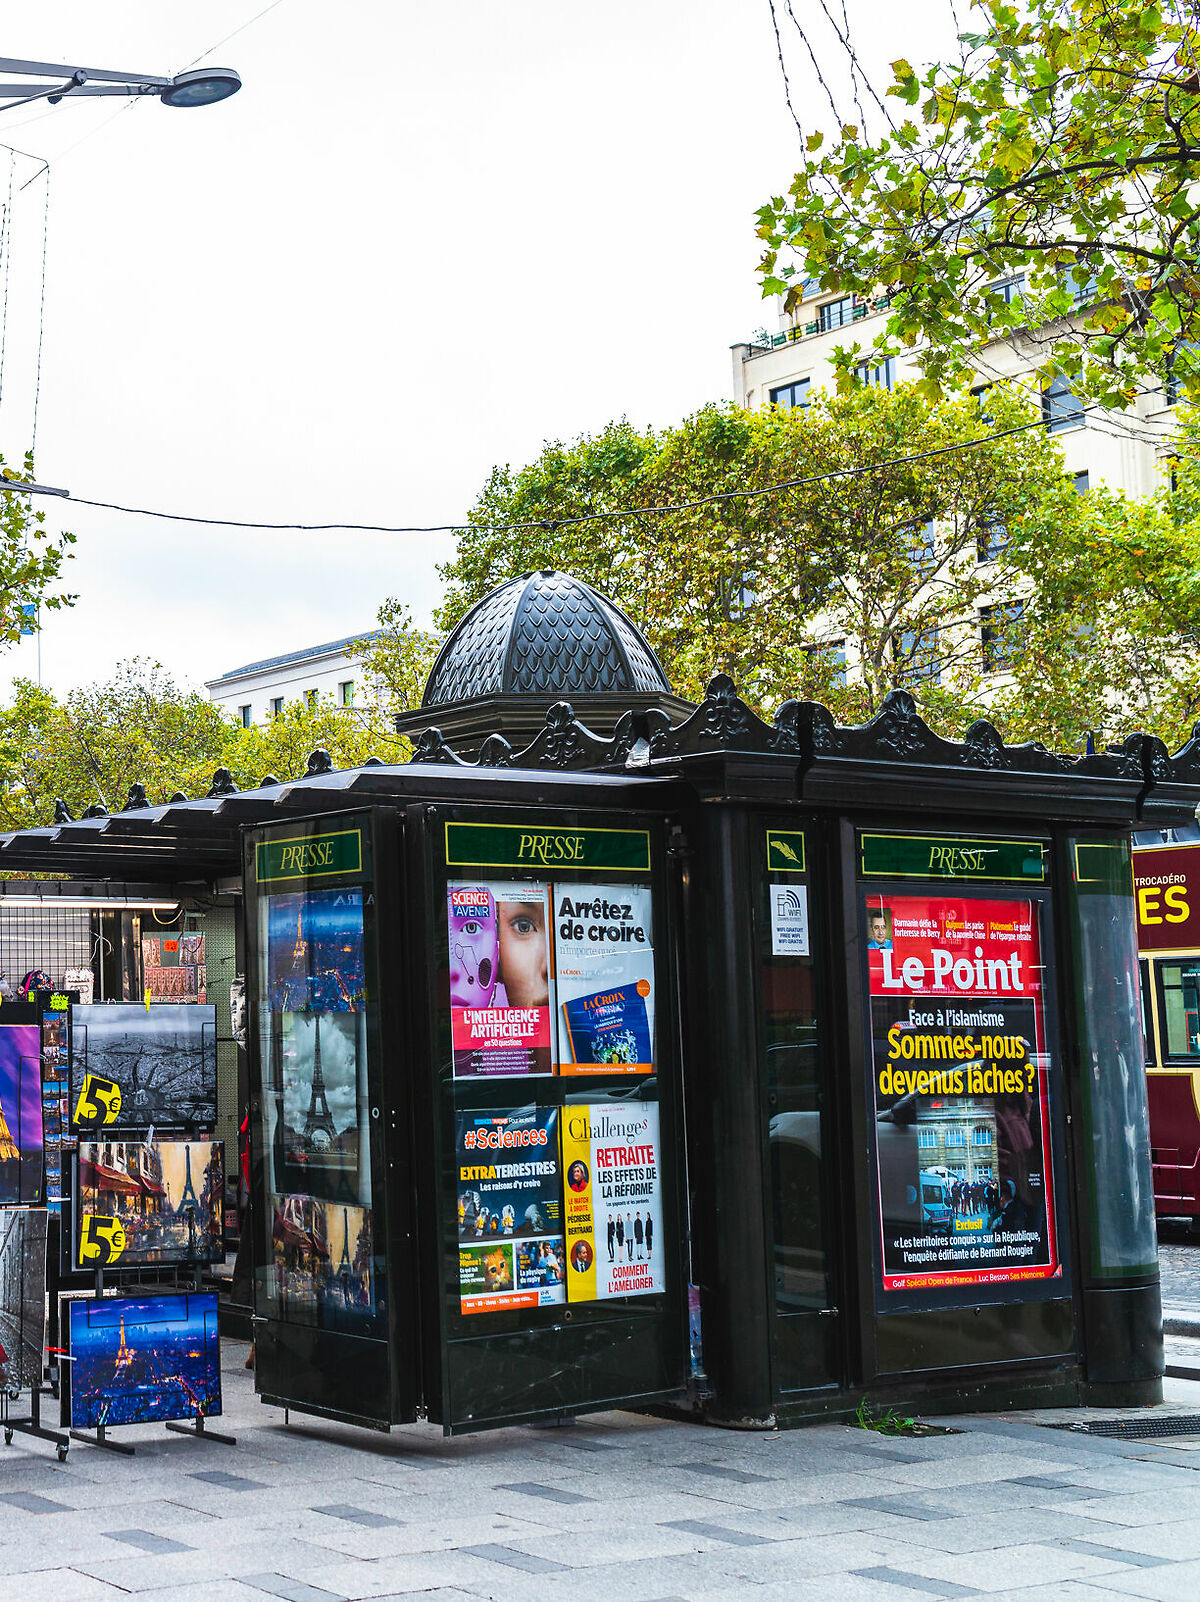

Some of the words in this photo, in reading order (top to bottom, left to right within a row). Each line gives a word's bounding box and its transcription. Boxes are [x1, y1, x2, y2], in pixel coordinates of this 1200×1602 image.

[280, 841, 335, 873] PRESSE
[517, 835, 585, 865] PRESSE
[928, 846, 986, 878] PRESSE
[1135, 873, 1187, 886] TROCADÉRO
[452, 892, 489, 906] SCIENCES
[456, 906, 489, 917] AVENIR
[559, 897, 634, 921] Arrêtez
[560, 919, 584, 941] de
[588, 922, 646, 943] croire
[894, 918, 919, 928] Darmanin
[932, 919, 938, 928] la
[920, 928, 927, 938] de
[945, 929, 952, 939] de
[990, 931, 996, 940] de
[880, 948, 925, 988] Le
[930, 946, 1024, 991] Point
[463, 1009, 540, 1024] L'INTELLIGENCE
[908, 1009, 935, 1026] Face
[936, 1009, 944, 1026] à
[946, 1009, 1005, 1027] l'islamisme
[470, 1023, 535, 1038] ARTIFICIELLE
[498, 1039, 523, 1048] questions
[887, 1028, 1025, 1060] Sommes-nous
[879, 1063, 964, 1095] devenus
[464, 1126, 548, 1149] #Sciences
[569, 1116, 648, 1144] Challenges
[596, 1145, 655, 1168] RETRAITE
[460, 1160, 557, 1181] EXTRATERRESTRES
[598, 1170, 612, 1184] LES
[615, 1168, 644, 1182] EFFETS
[646, 1167, 657, 1180] DE
[480, 1182, 492, 1191] Les
[492, 1181, 513, 1191] raisons
[523, 1179, 541, 1188] croire
[602, 1185, 612, 1199] LA
[615, 1182, 653, 1198] RÉFORME
[568, 1225, 593, 1236] BERTRAND
[955, 1218, 983, 1231] Exclusif
[913, 1234, 948, 1248] territoires
[983, 1235, 993, 1243] sur
[994, 1232, 1001, 1243] la
[1002, 1230, 1041, 1243] République,
[903, 1250, 937, 1264] l'enquête
[938, 1248, 969, 1261] édifiante
[970, 1247, 979, 1258] de
[980, 1246, 1006, 1258] Bernard
[1007, 1244, 1033, 1257] Rougier
[612, 1264, 649, 1279] COMMENT
[892, 1280, 905, 1288] Golf
[928, 1277, 944, 1286] Open
[945, 1276, 953, 1284] de
[953, 1275, 973, 1284] France
[978, 1274, 989, 1282] Luc
[989, 1273, 1010, 1282] Besson
[1010, 1271, 1020, 1280] Ses
[1020, 1271, 1046, 1279] Mémoires
[608, 1276, 654, 1293] L'AMÉLIORER
